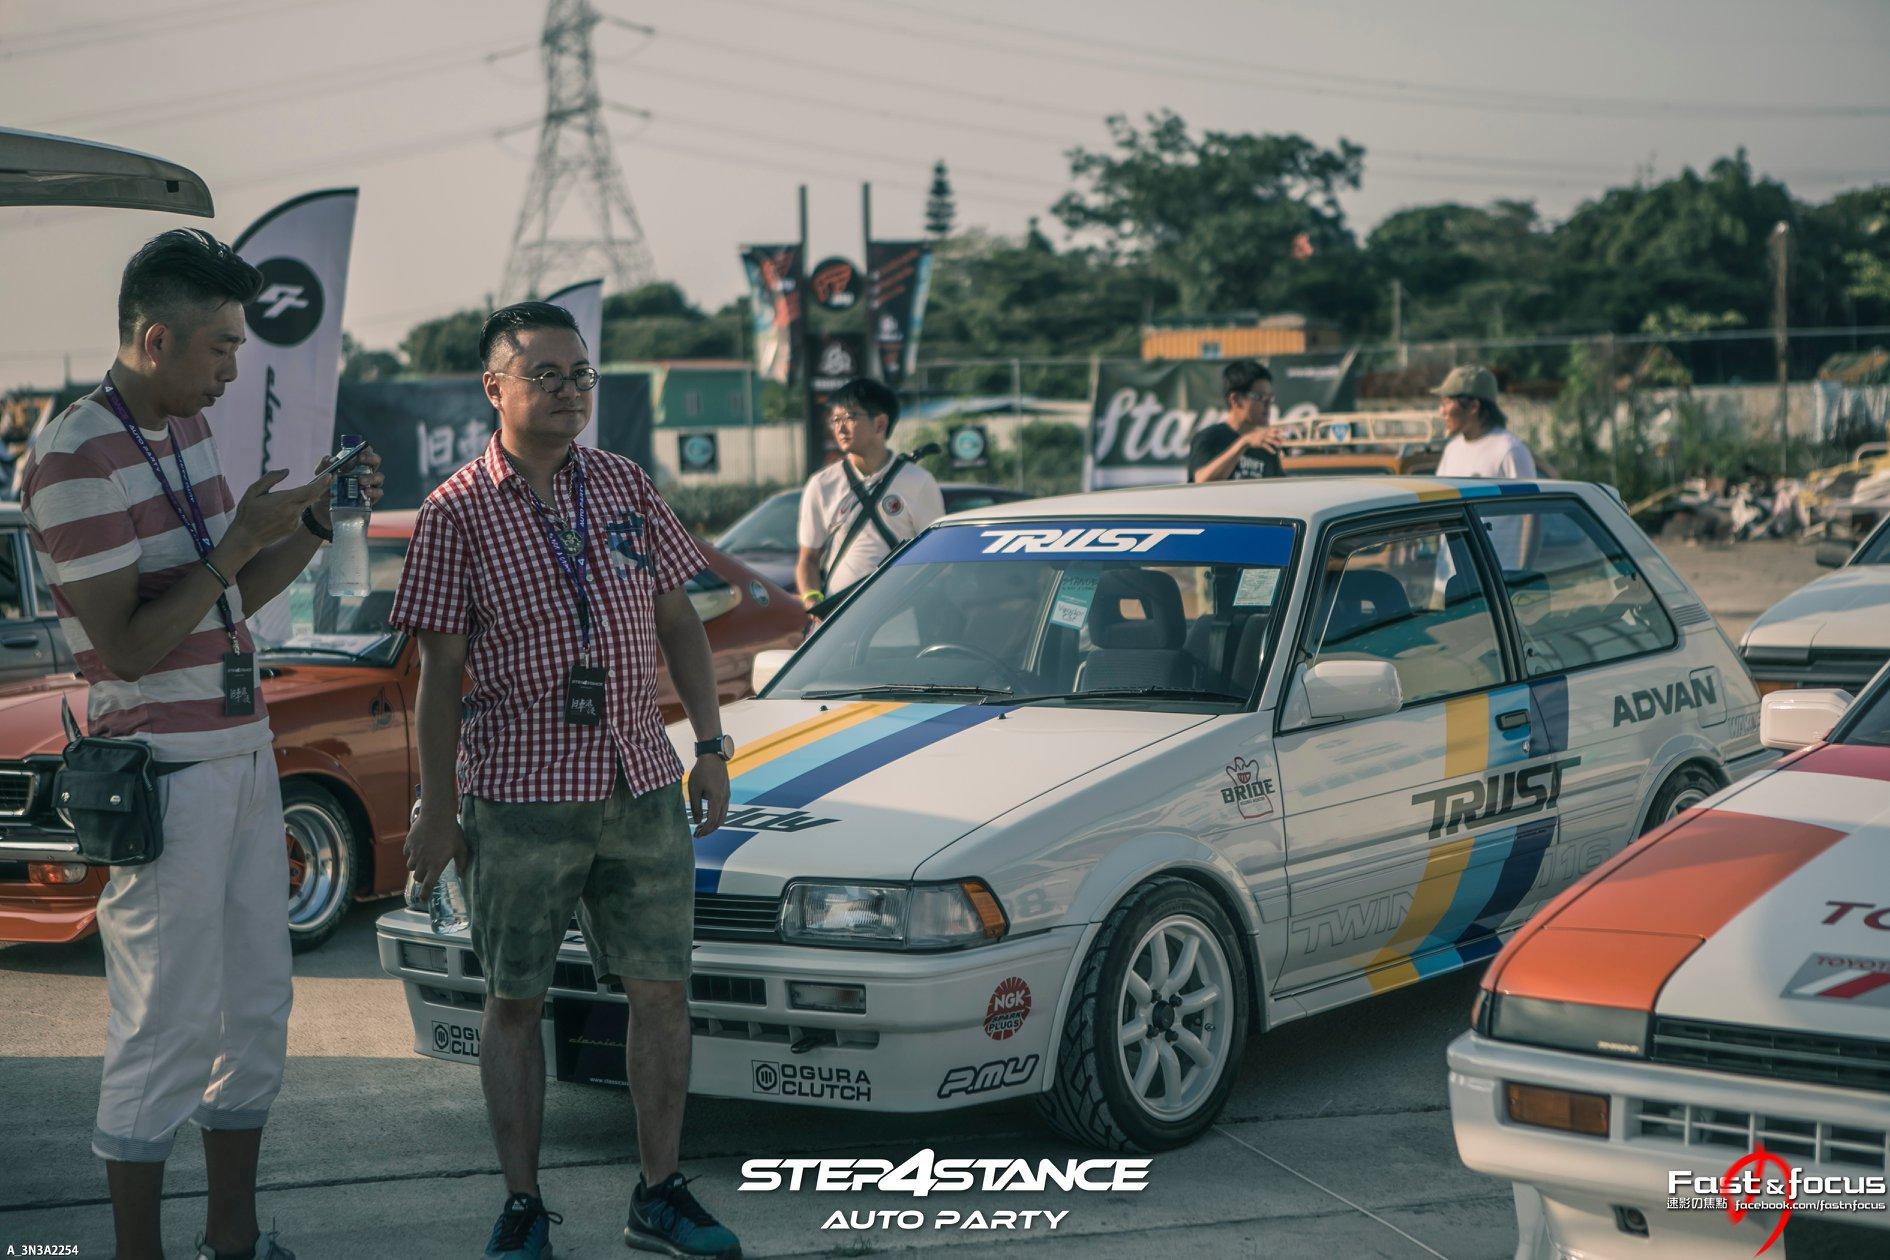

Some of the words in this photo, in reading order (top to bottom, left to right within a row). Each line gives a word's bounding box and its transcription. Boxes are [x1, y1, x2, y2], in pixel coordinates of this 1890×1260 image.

[980, 528, 1206, 554] TRUST
[1612, 675, 1718, 729] ADVAN
[1220, 778, 1276, 805] BRIDE
[1411, 756, 1582, 841] TRUST
[993, 989, 1026, 1012] NGK
[988, 1018, 1020, 1032] PLUGS
[781, 1063, 872, 1085] OGURA
[781, 1080, 872, 1102] CLUTCH
